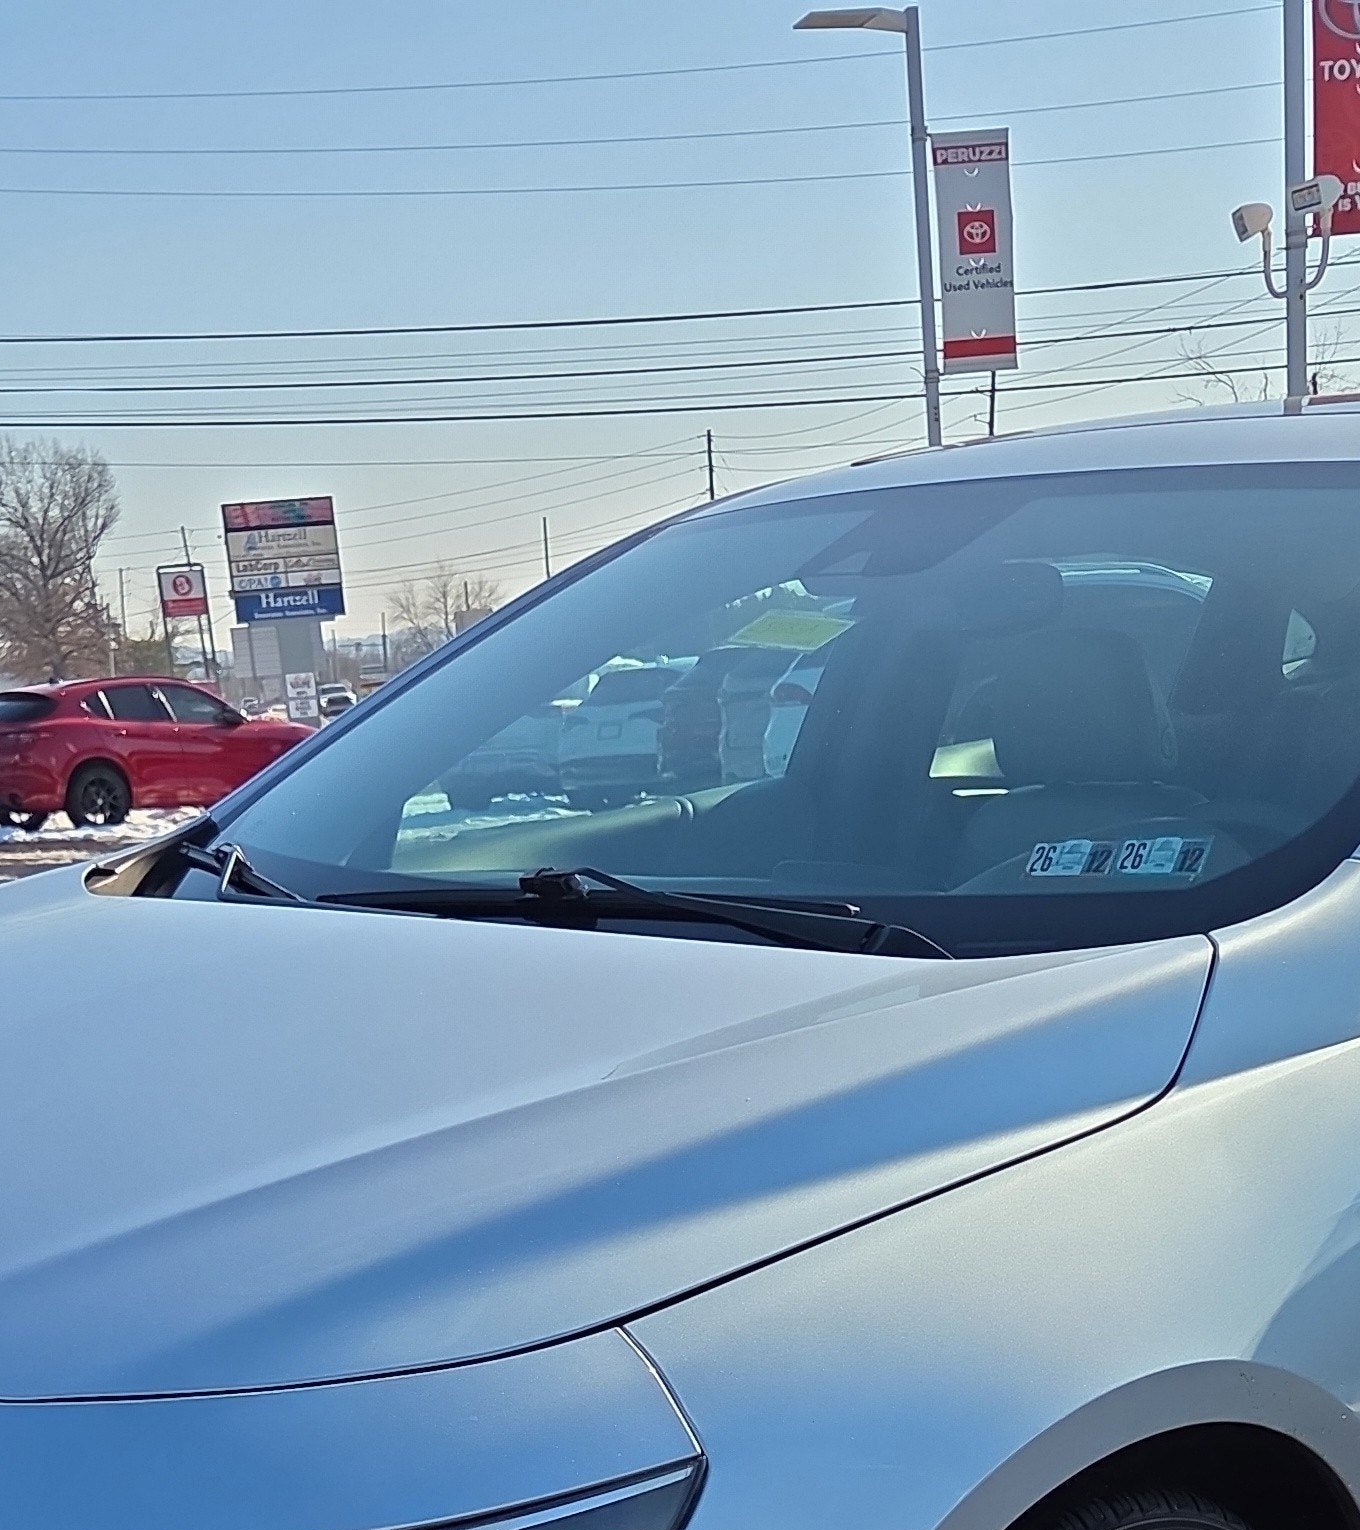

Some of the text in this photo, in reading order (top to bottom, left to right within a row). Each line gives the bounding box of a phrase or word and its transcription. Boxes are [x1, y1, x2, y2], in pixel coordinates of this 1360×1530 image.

[936, 144, 1007, 164] PERUZZI
[1338, 198, 1352, 212] IS
[956, 262, 1002, 276] Certified
[943, 281, 971, 293] Used
[1029, 845, 1113, 874] 26 12
[1119, 842, 1206, 873] 26 12
